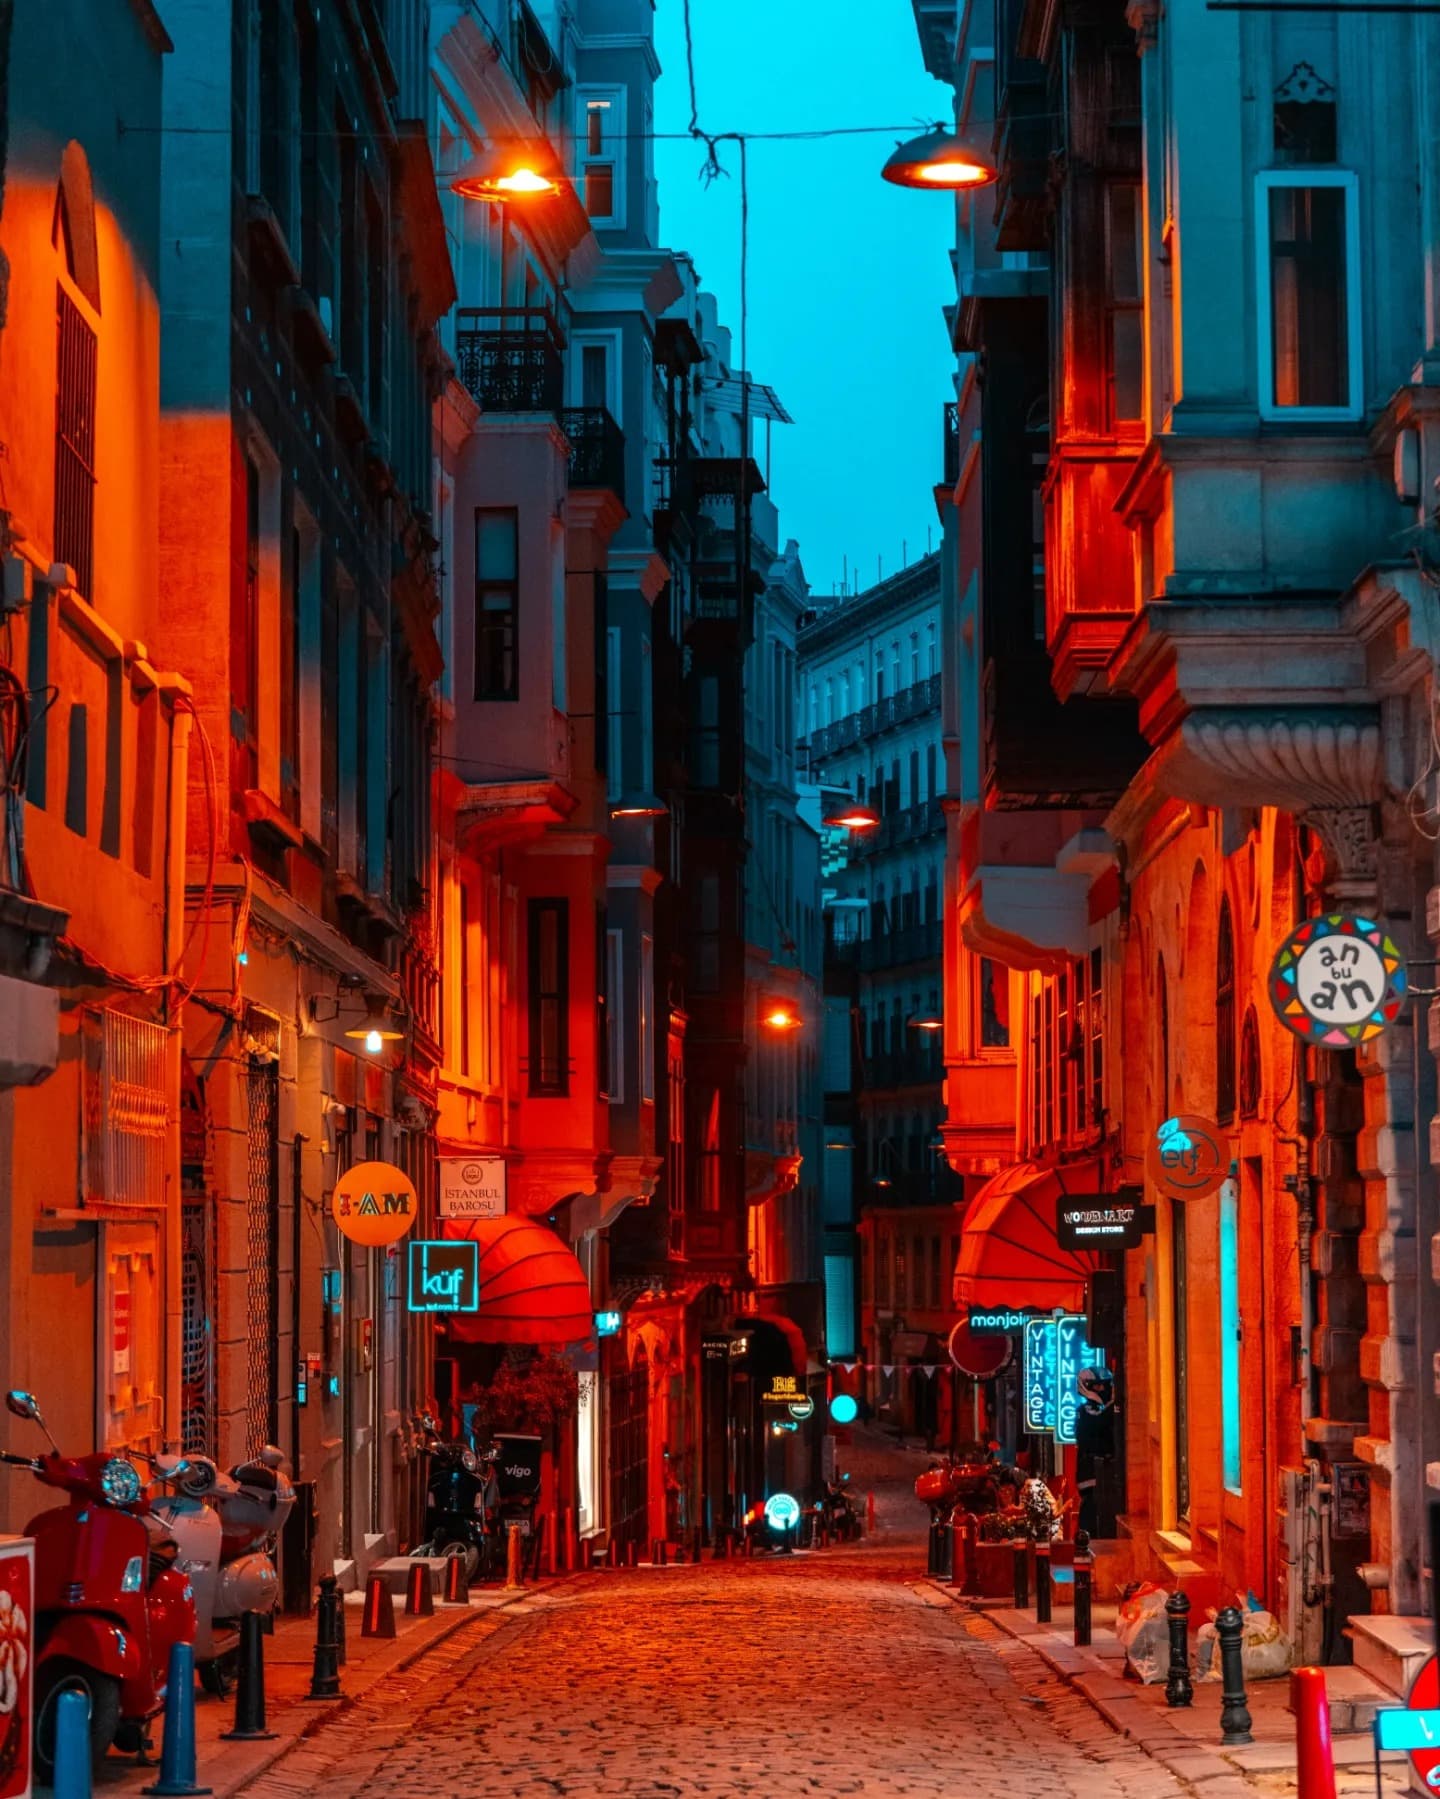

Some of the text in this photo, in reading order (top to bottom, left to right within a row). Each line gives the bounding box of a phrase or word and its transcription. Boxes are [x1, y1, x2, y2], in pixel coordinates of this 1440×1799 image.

[1319, 943, 1360, 967] an
[1331, 967, 1352, 980] bu
[1310, 979, 1375, 1011] an
[339, 1192, 411, 1217] I-AM
[445, 1187, 500, 1199] İSTANBUL
[450, 1200, 496, 1211] BAROSU
[1075, 1227, 1101, 1235] DESIGN
[422, 1267, 464, 1303] küf
[1030, 1329, 1044, 1422] VINTAGE
[1061, 1329, 1076, 1435] VINTAGE
[505, 1465, 531, 1478] vigo
